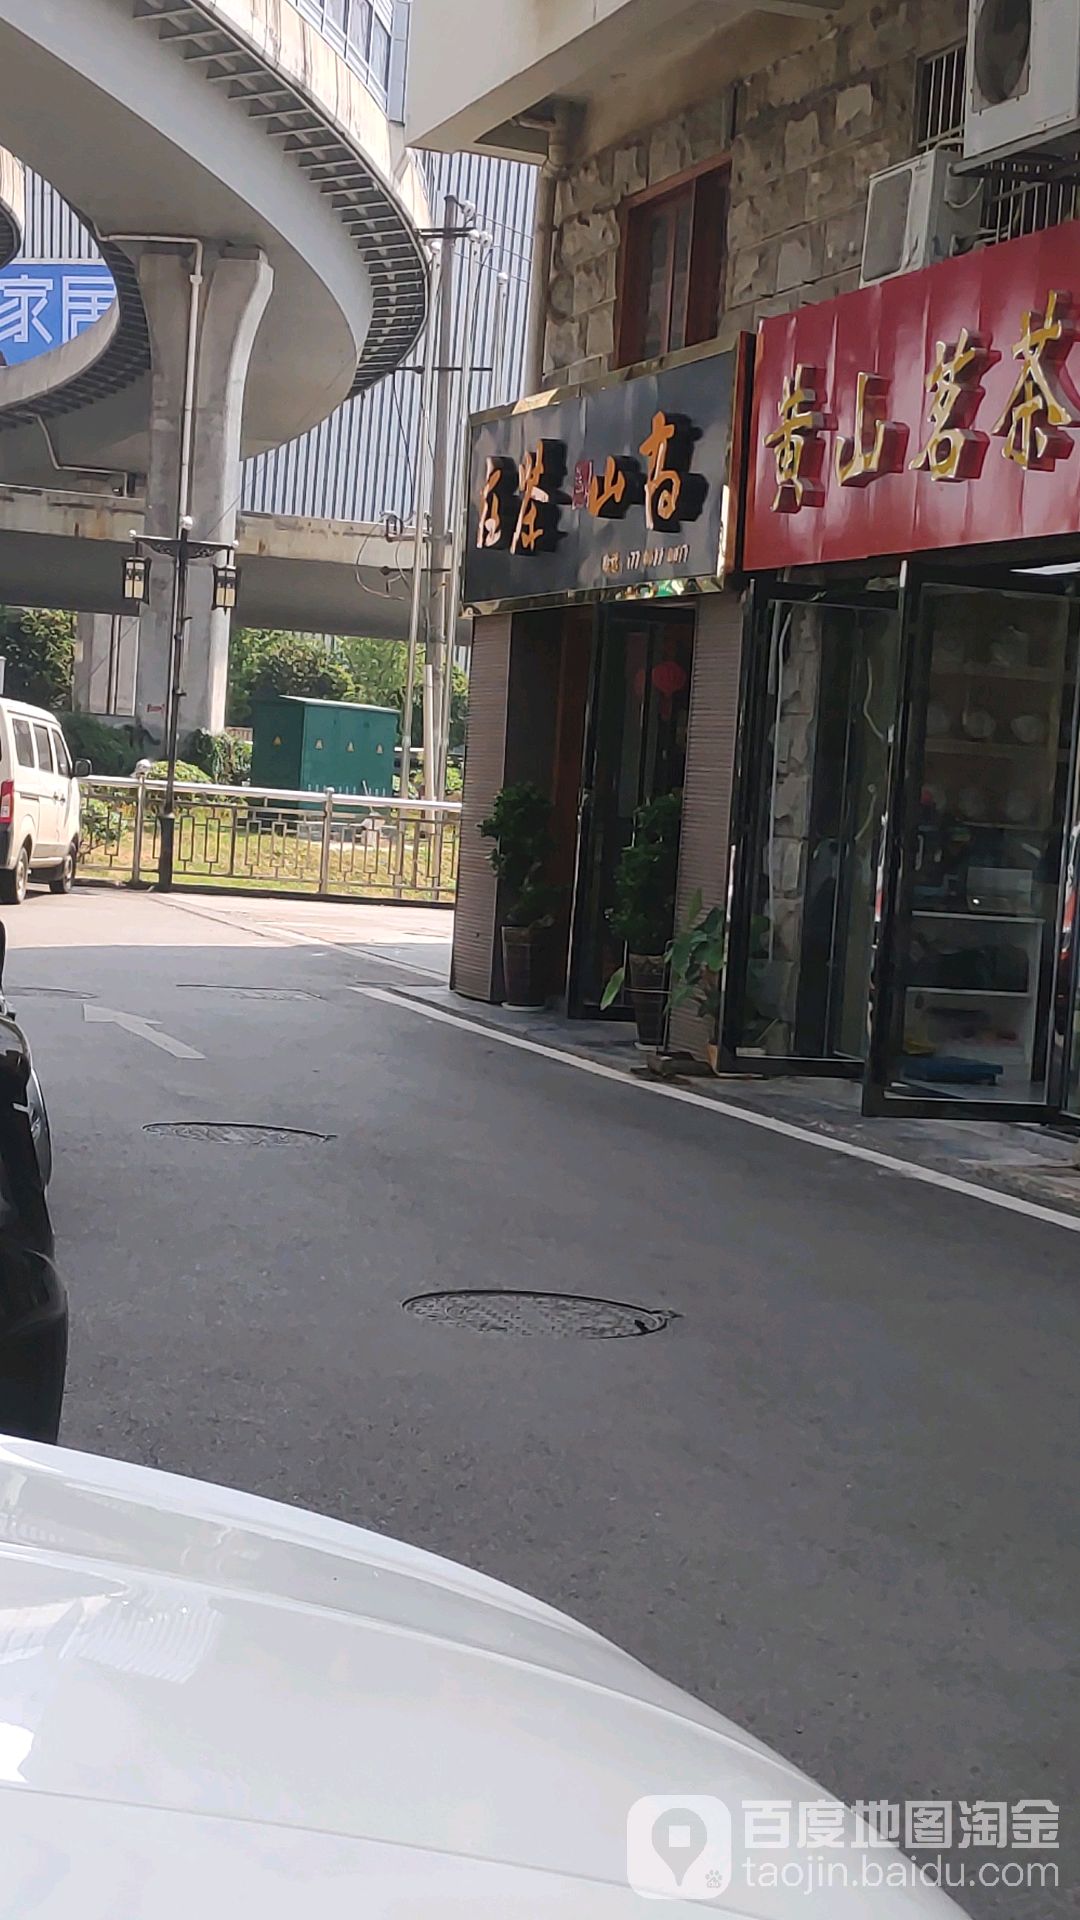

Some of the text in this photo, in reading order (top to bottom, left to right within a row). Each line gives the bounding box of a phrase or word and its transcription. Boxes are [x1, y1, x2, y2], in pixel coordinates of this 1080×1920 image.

[0, 273, 117, 344] 家居
[763, 288, 1072, 513] 黄山茗茶
